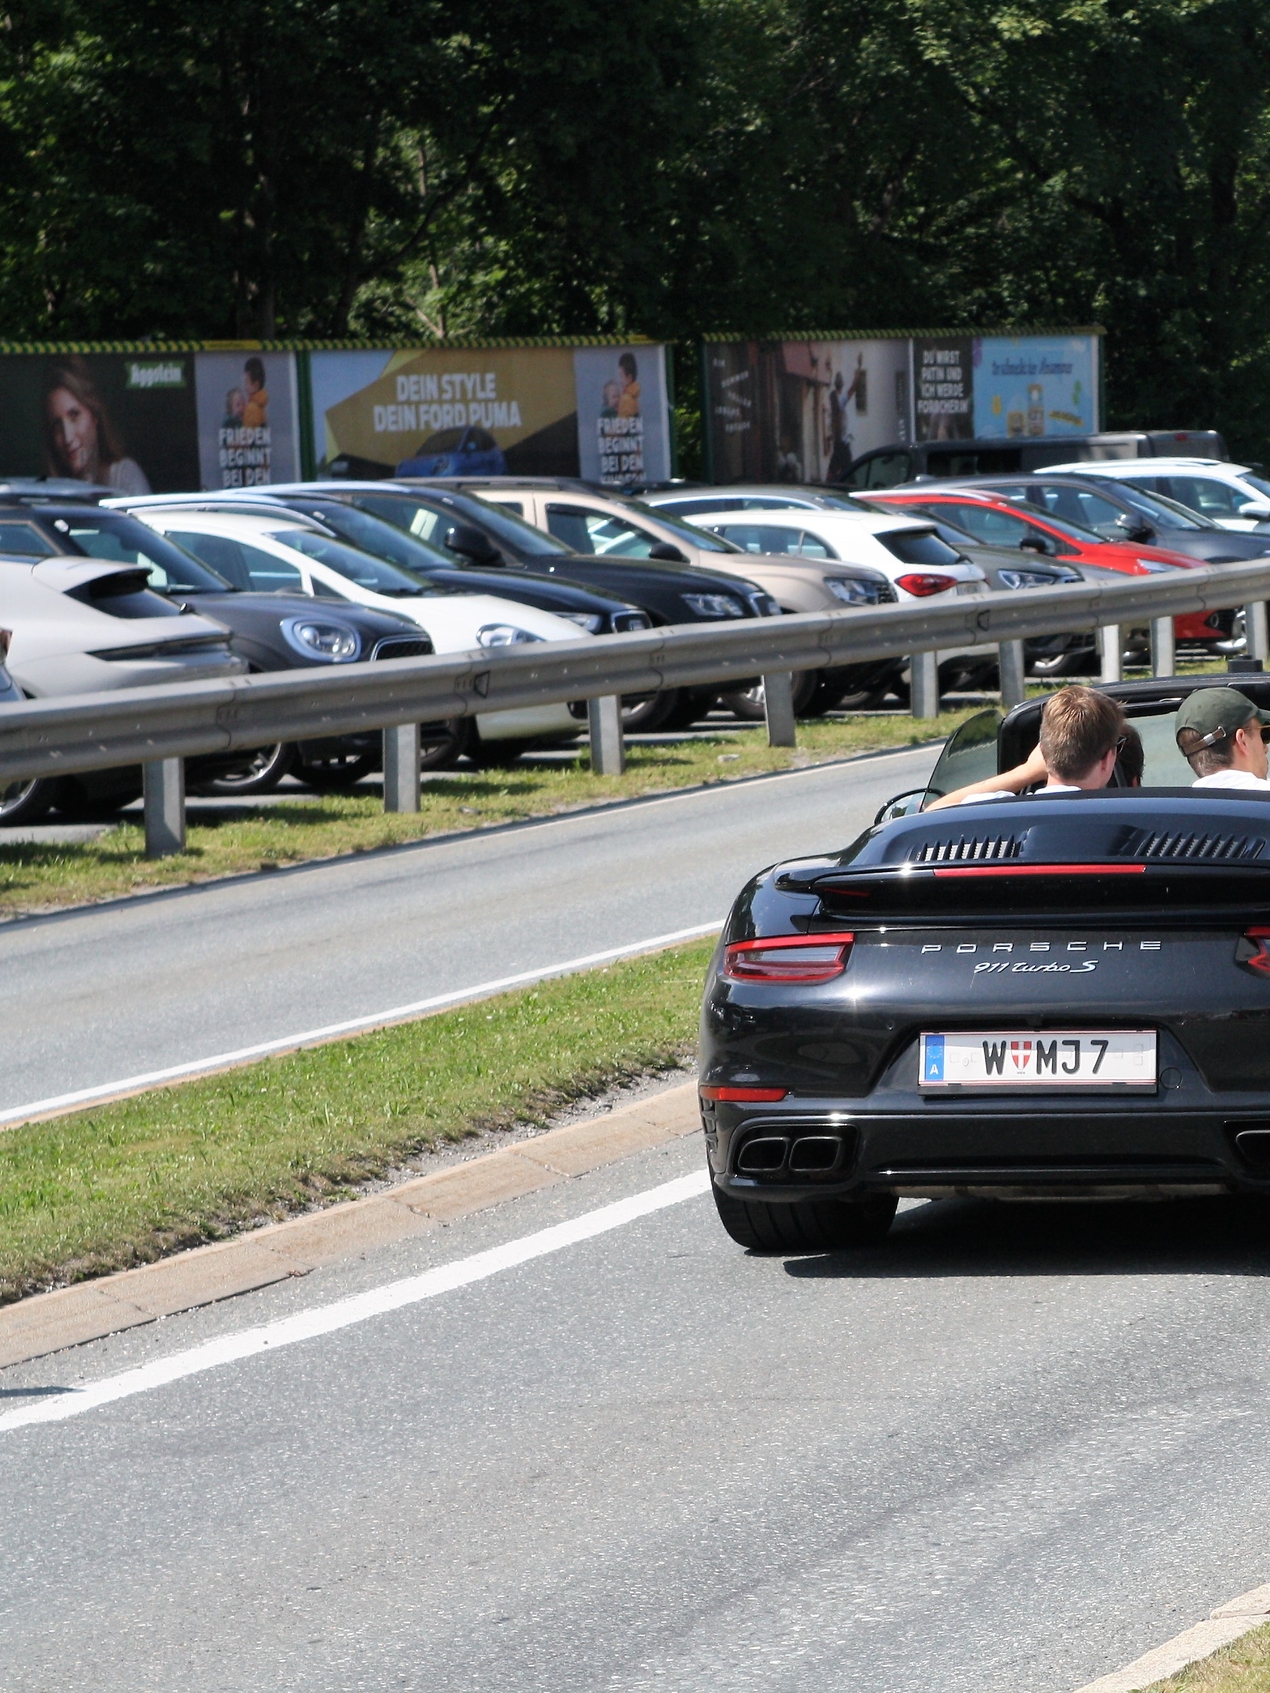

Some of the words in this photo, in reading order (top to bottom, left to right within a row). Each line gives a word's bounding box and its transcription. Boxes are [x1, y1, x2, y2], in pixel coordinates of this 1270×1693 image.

[396, 374, 439, 402] DEIN
[441, 372, 497, 400] STYLE
[373, 404, 417, 432] DEIN
[419, 403, 467, 430] FORD
[469, 401, 522, 428] PUMA
[597, 417, 643, 435] FRIEDEN
[219, 427, 271, 446] FRIEDEN
[598, 436, 645, 454] BEGINNT
[219, 448, 272, 467] BEGINNT
[601, 455, 619, 472] BEI
[621, 454, 644, 471] DEN
[222, 469, 242, 487] BEI
[245, 468, 271, 485] DEN
[921, 941, 1162, 953] PORSCHE
[974, 961, 1010, 973] 911
[1011, 961, 1071, 973] turbo
[1070, 960, 1098, 973] S
[982, 1040, 1007, 1075] W
[929, 1064, 939, 1075] A
